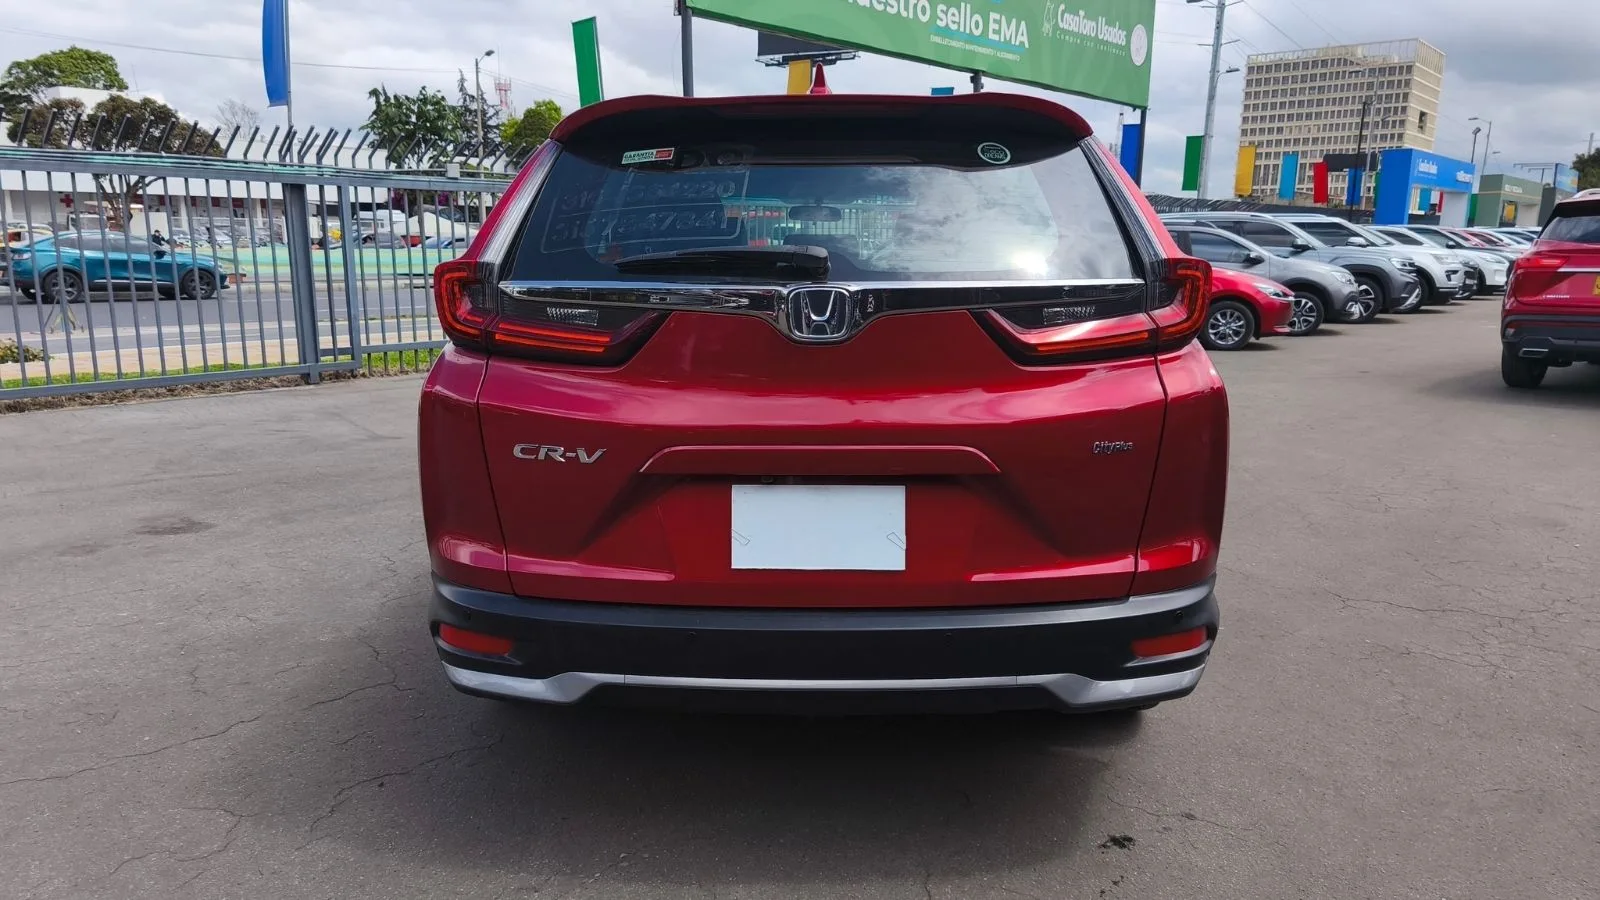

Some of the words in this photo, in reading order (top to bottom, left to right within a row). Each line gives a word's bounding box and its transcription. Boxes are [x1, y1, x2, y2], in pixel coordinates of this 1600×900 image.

[848, 0, 930, 23] estro
[936, 2, 984, 37] sello
[988, 12, 1030, 49] EMA
[1058, 3, 1097, 37] CasaToro
[1097, 16, 1127, 46] Usados
[513, 443, 607, 464] CR-V
